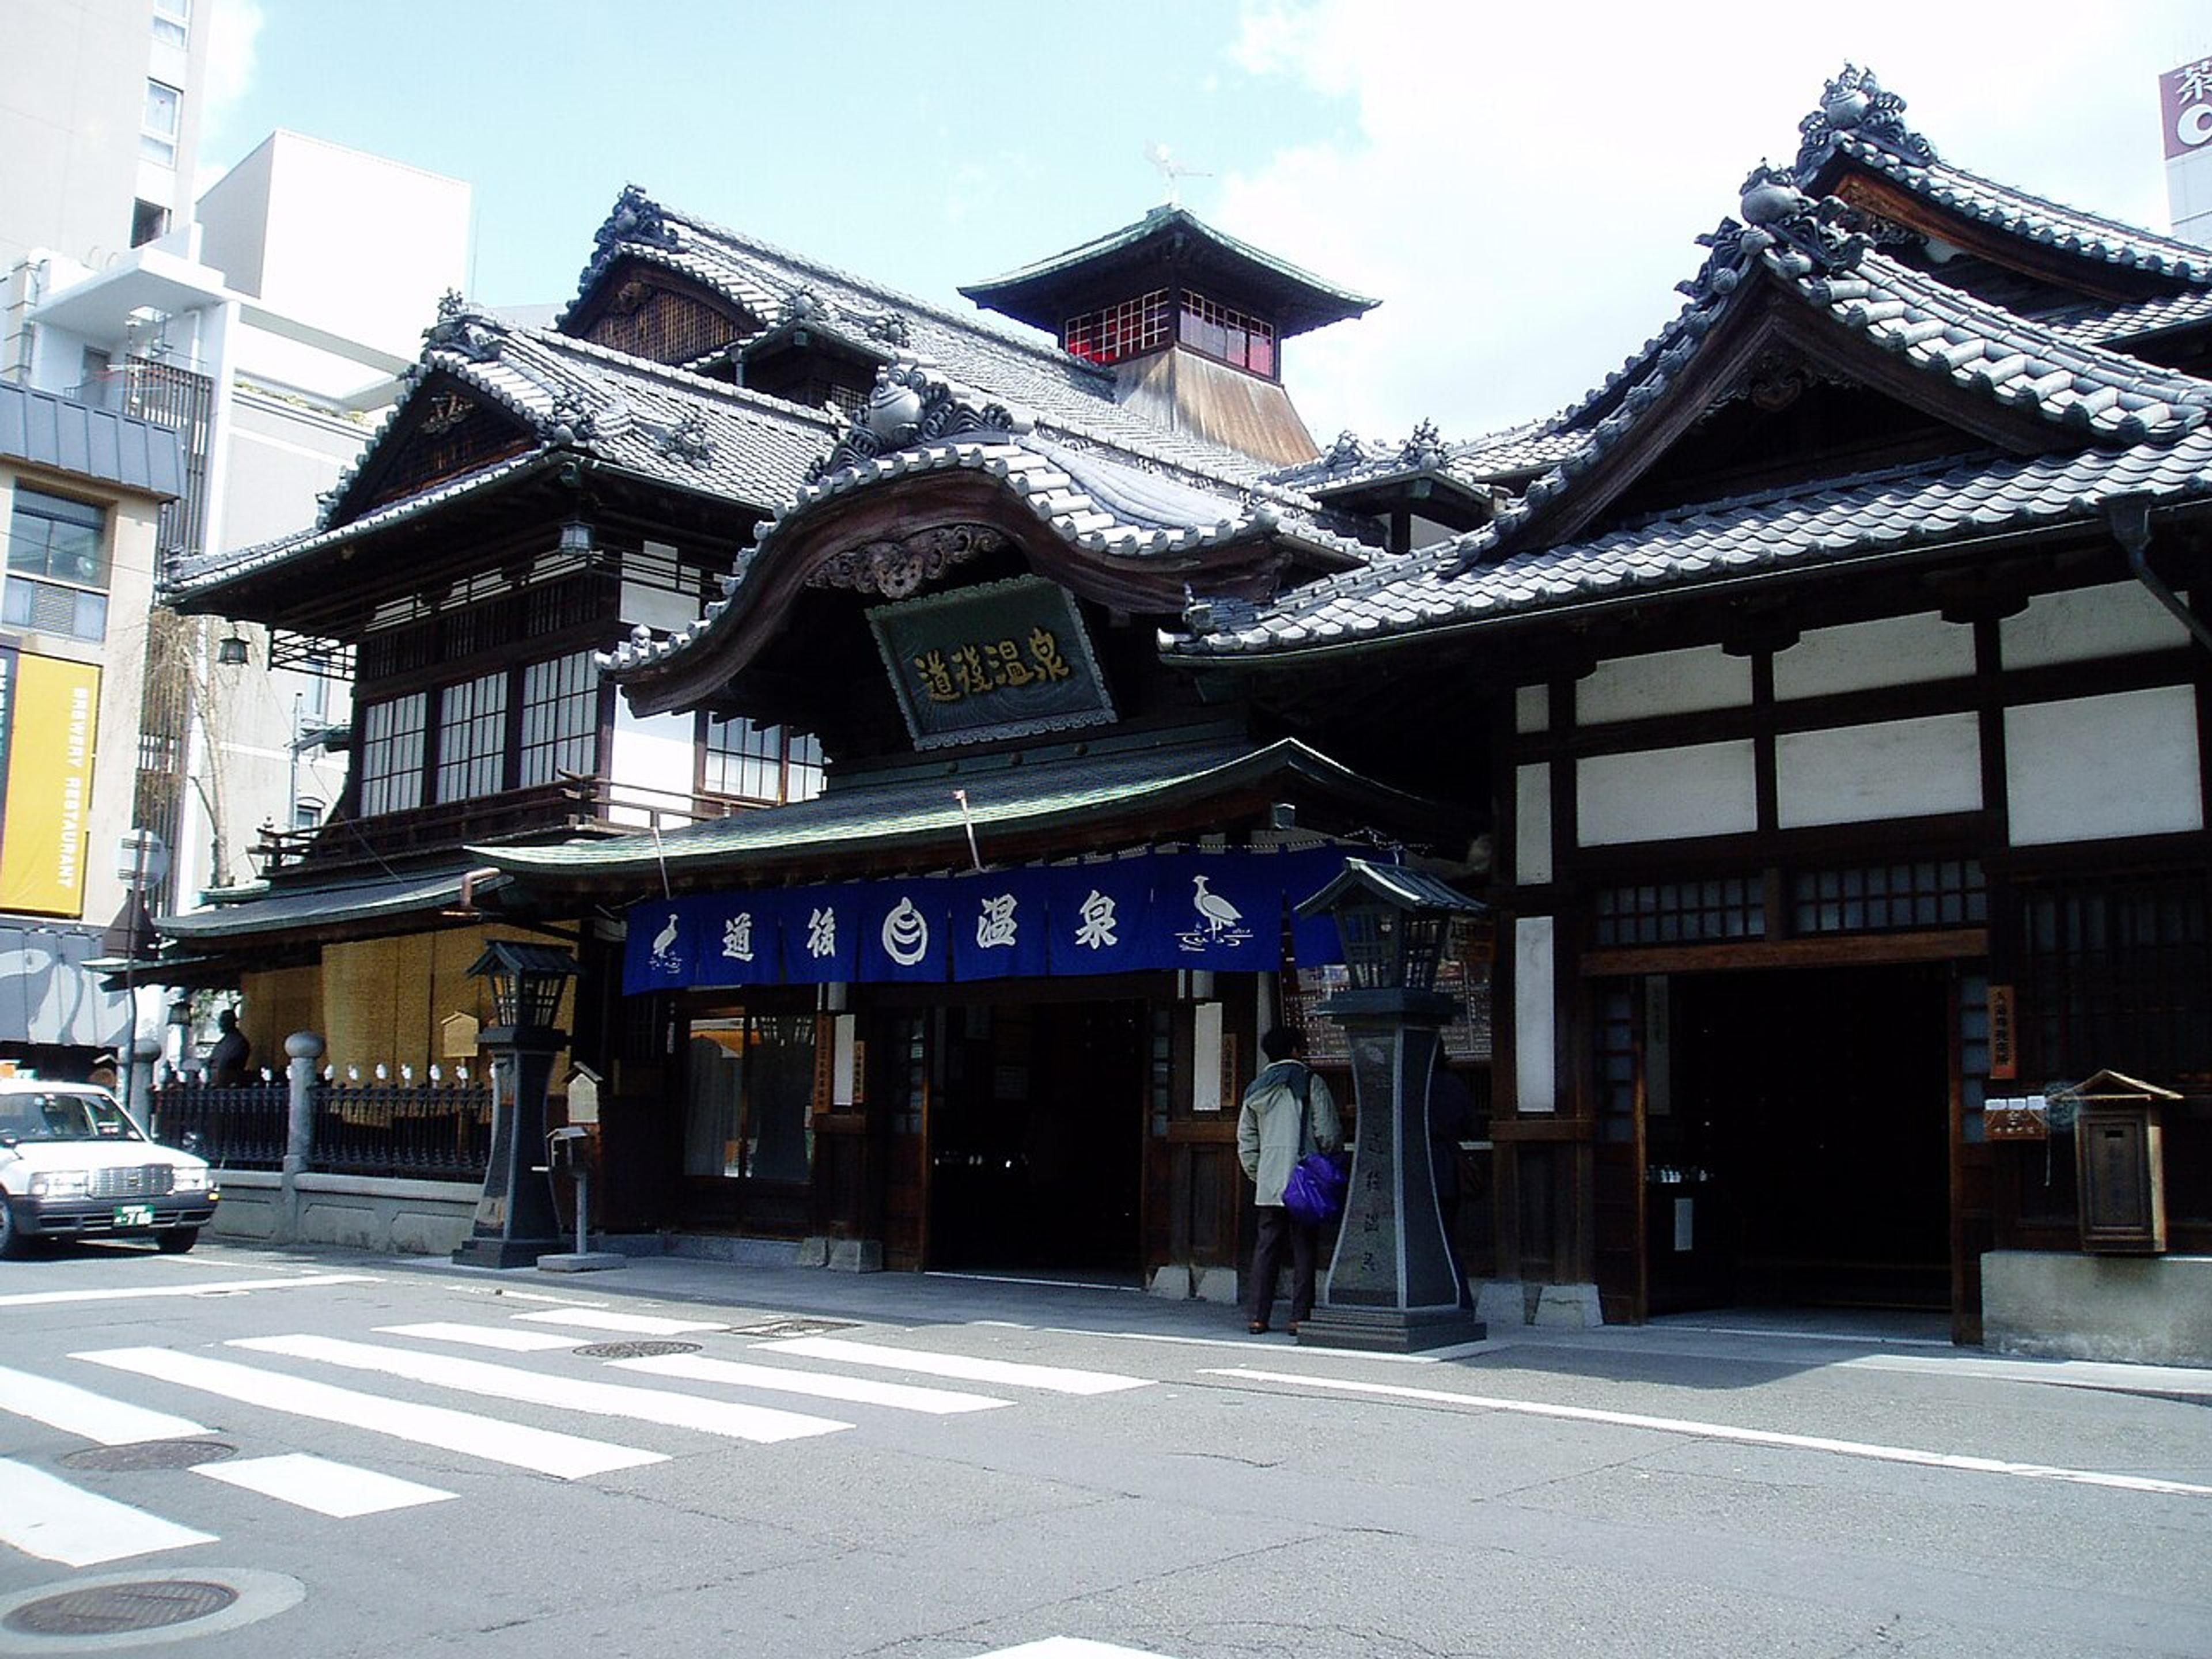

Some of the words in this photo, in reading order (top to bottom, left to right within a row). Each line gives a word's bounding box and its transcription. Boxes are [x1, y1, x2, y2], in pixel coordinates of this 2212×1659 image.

[913, 626, 1070, 702] 道後温泉
[67, 687, 88, 768] BREWERY
[58, 777, 81, 888] RESTAURANT
[976, 889, 1118, 949] 温泉
